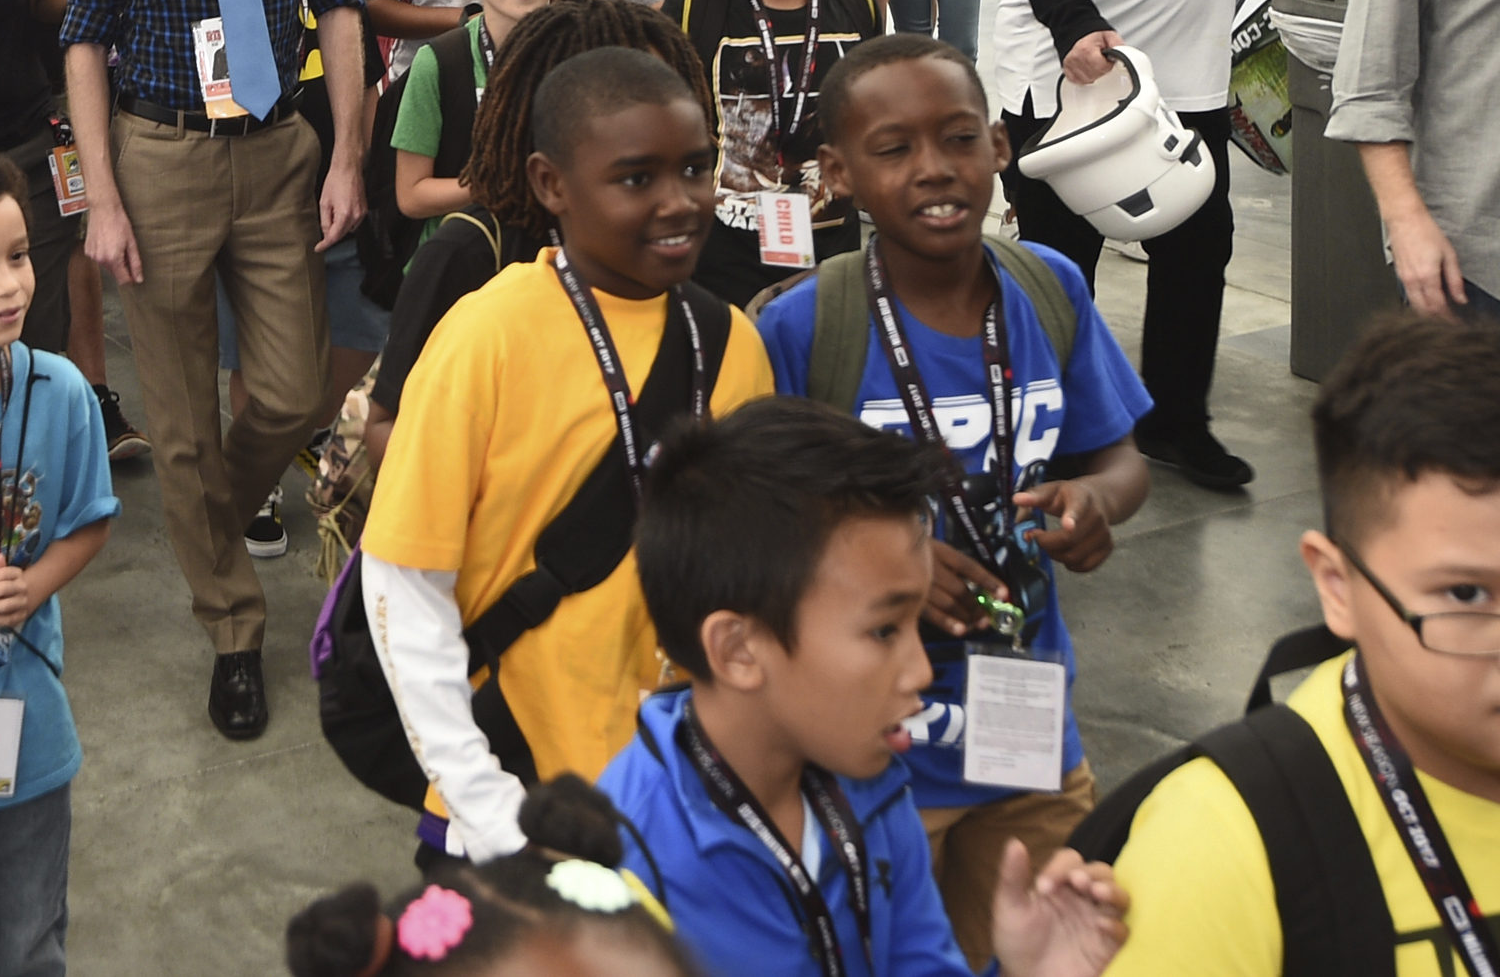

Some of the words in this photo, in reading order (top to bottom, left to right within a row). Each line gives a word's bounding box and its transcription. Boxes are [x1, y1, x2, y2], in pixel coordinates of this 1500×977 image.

[715, 195, 758, 216] STA
[775, 198, 794, 245] CHILD
[589, 326, 606, 350] OCT
[598, 348, 616, 375] 2017
[1349, 693, 1371, 728] NEW
[1361, 726, 1400, 790] SEASON
[1391, 788, 1420, 825] OCT
[1407, 822, 1441, 869] 2017
